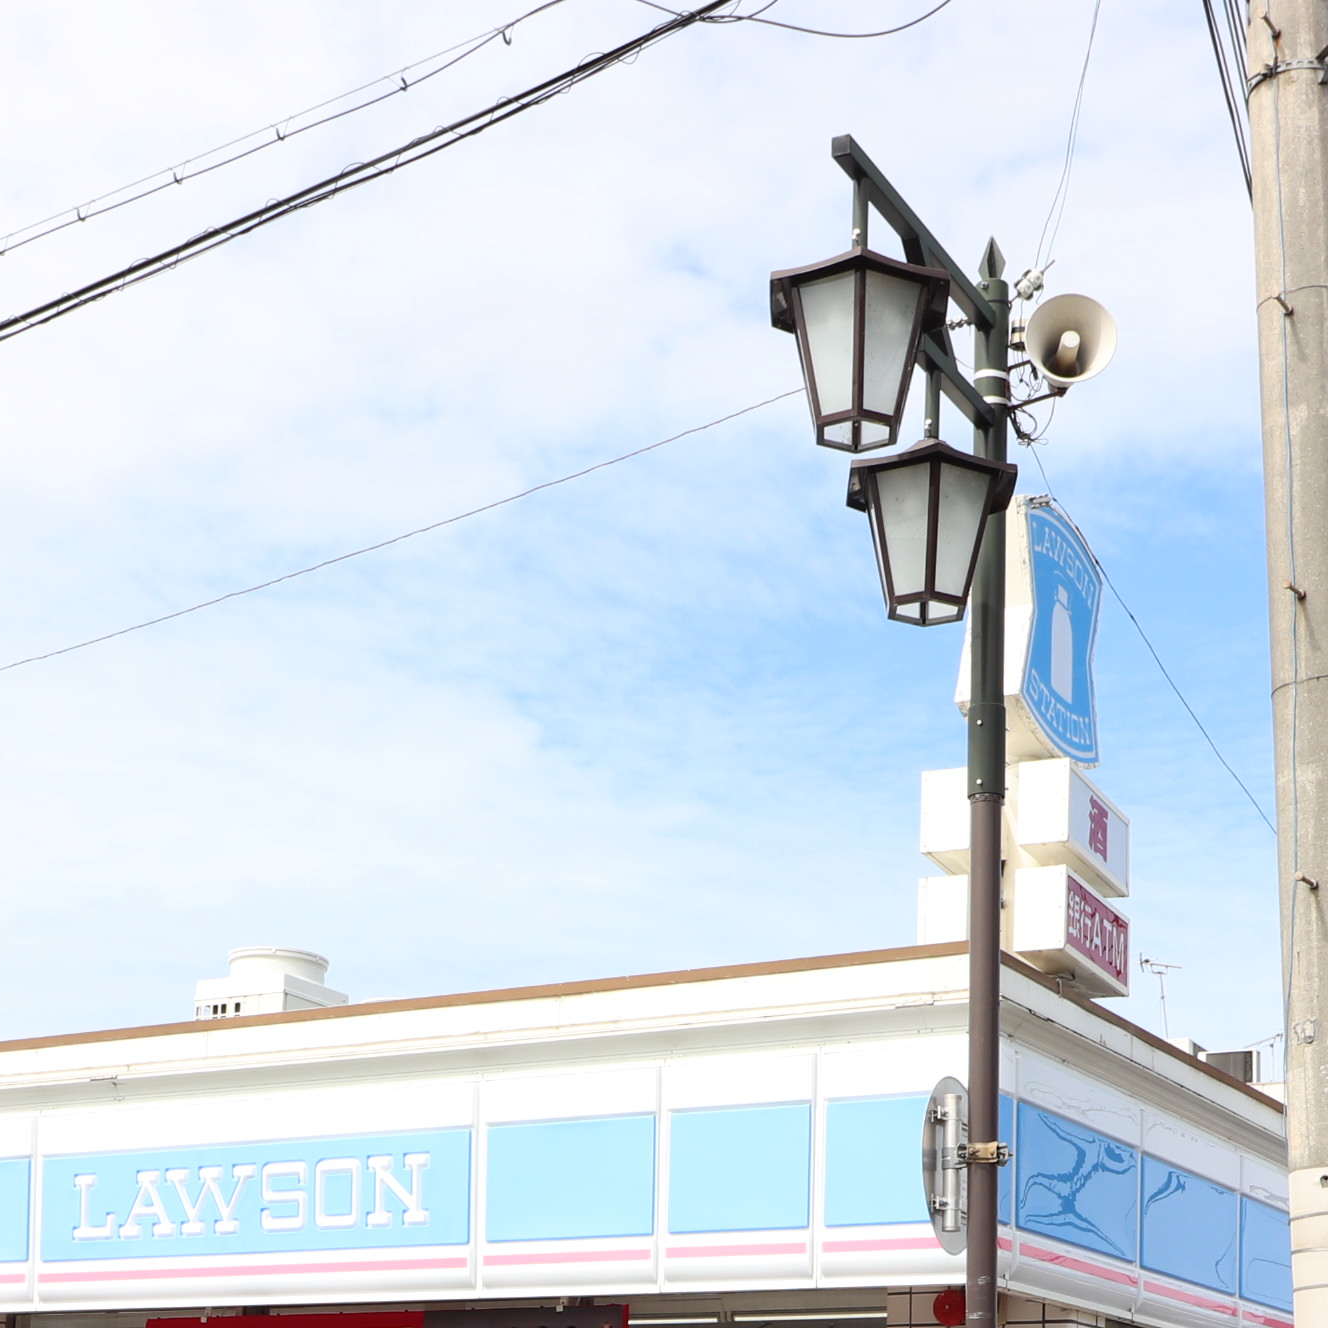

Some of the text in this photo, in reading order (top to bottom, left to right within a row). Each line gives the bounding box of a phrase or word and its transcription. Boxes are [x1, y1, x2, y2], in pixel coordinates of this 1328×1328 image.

[1032, 521, 1096, 608] LAWSON
[1030, 668, 1093, 747] STATION
[1088, 794, 1110, 863] 酒
[1067, 891, 1127, 976] 銀行ATM
[72, 1150, 430, 1241] LAWSON
